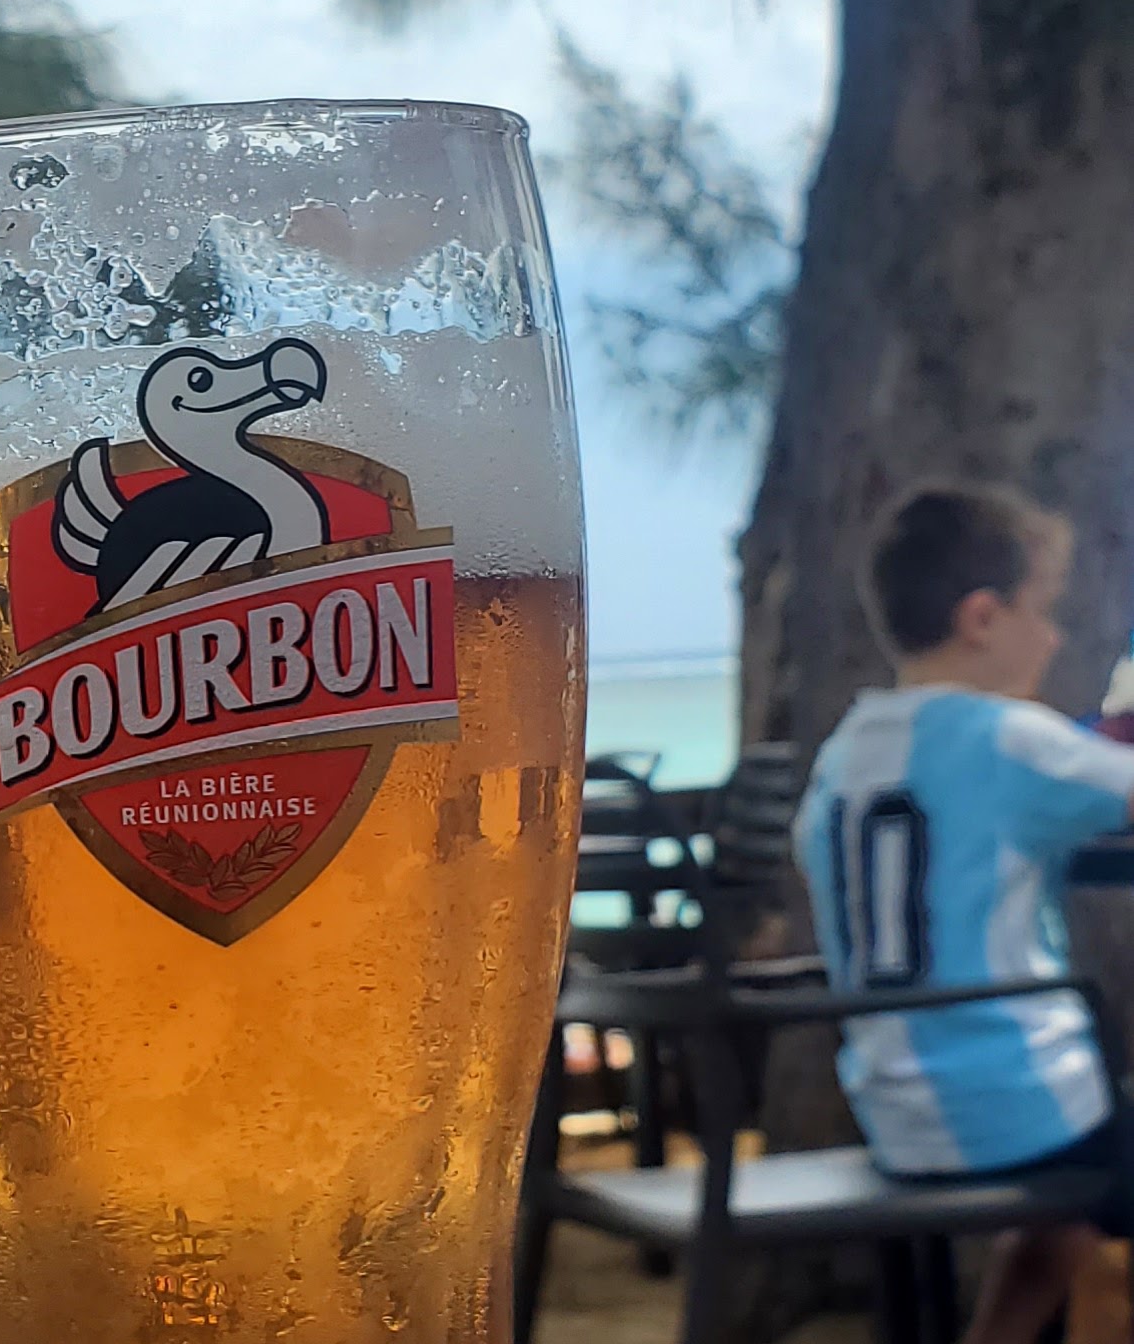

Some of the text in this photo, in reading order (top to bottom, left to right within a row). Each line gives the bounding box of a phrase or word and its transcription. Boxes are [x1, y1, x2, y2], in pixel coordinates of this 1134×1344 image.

[160, 772, 276, 799] LA BIÈRE
[121, 797, 317, 826] RÉUNIONNAISE
[827, 787, 928, 987] 10
